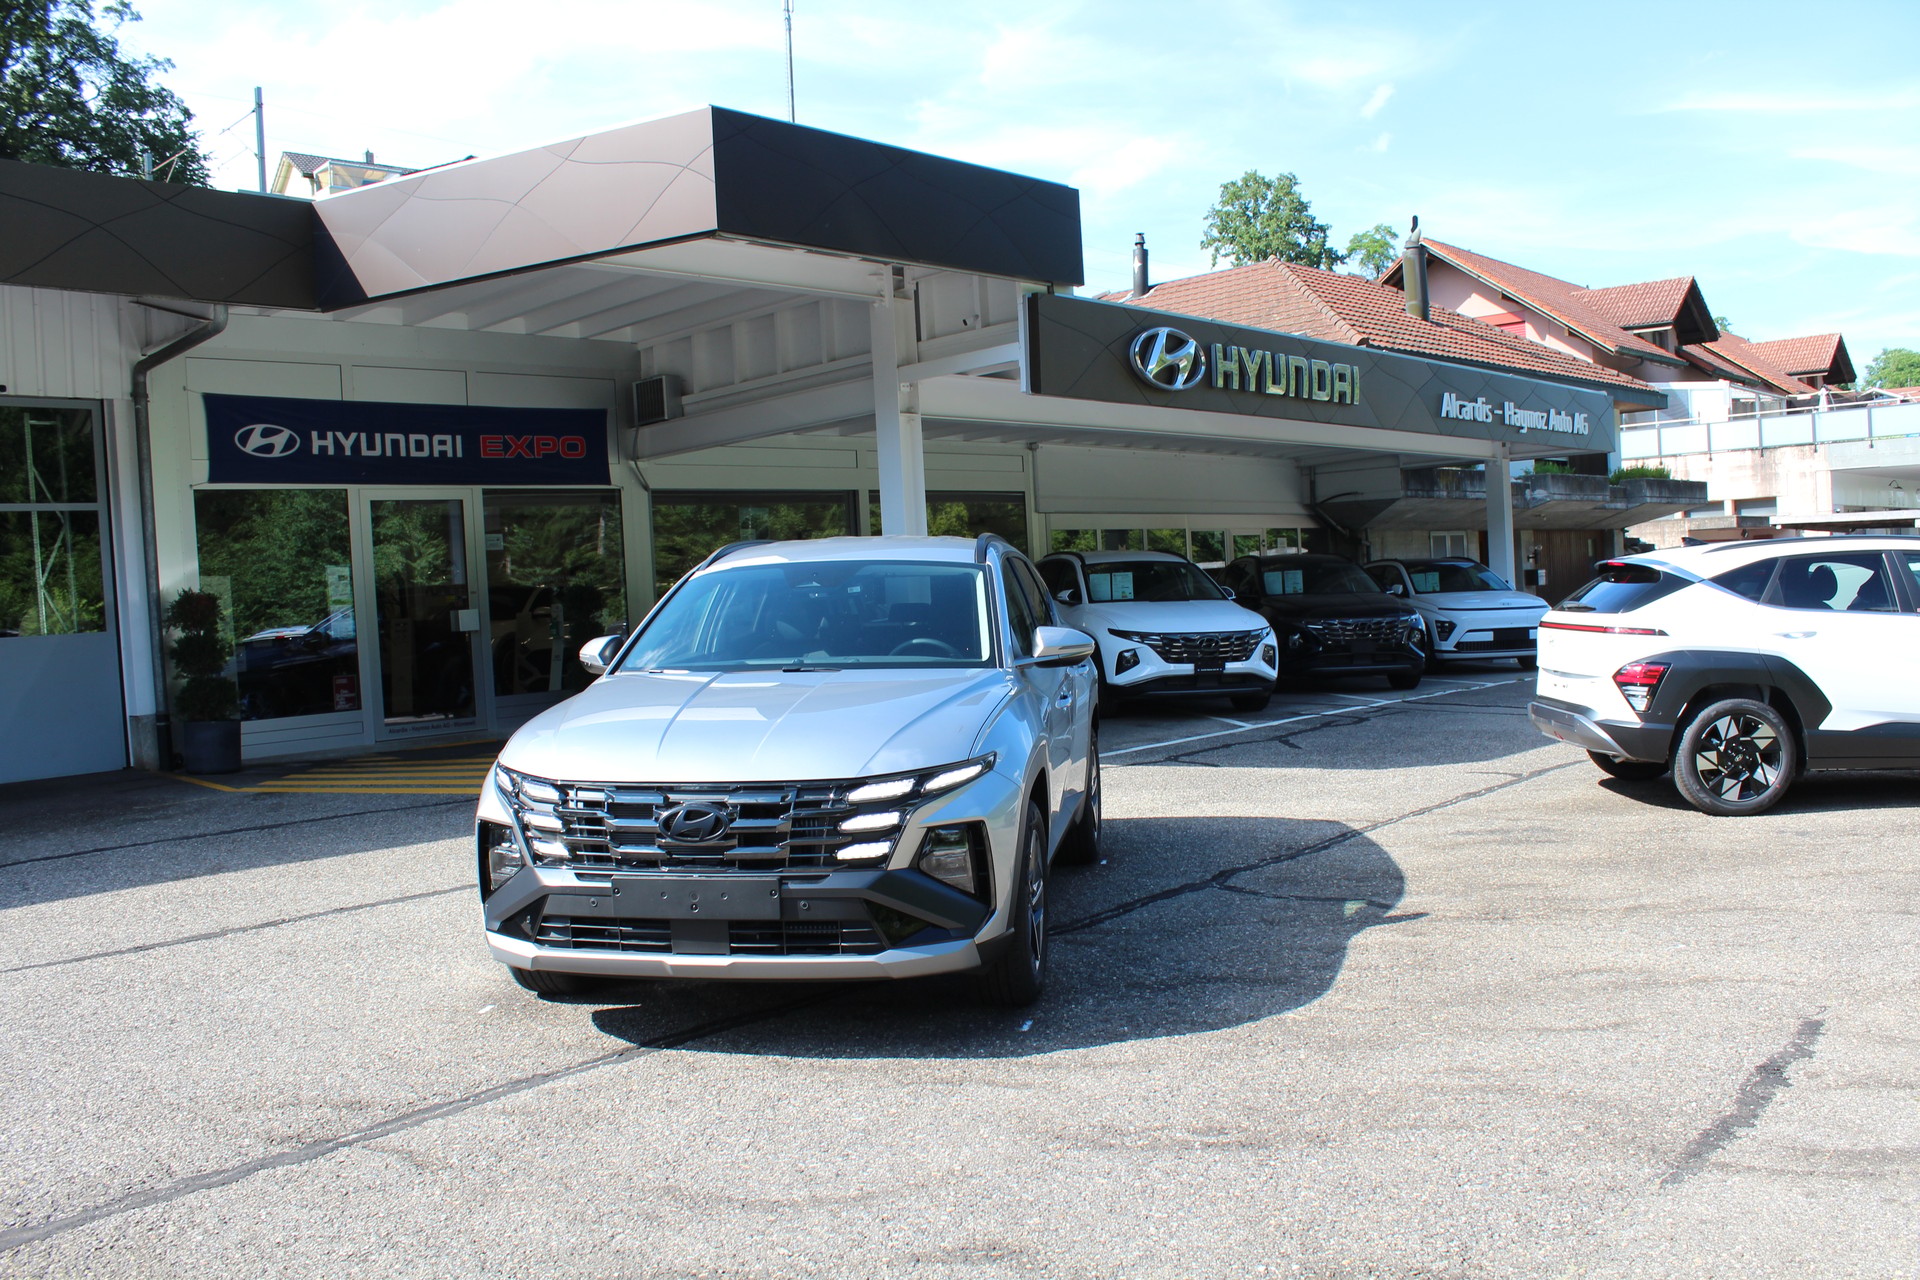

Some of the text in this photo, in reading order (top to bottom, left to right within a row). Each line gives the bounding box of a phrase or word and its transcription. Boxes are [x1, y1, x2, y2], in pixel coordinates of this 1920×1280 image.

[1211, 343, 1360, 405] HYUNDAI
[1441, 392, 1493, 423] Alcardis
[1504, 401, 1547, 434] Haymoz
[1549, 408, 1572, 434] Auto
[1573, 412, 1588, 435] AG
[311, 430, 587, 459] HYUNDAI EXPO
